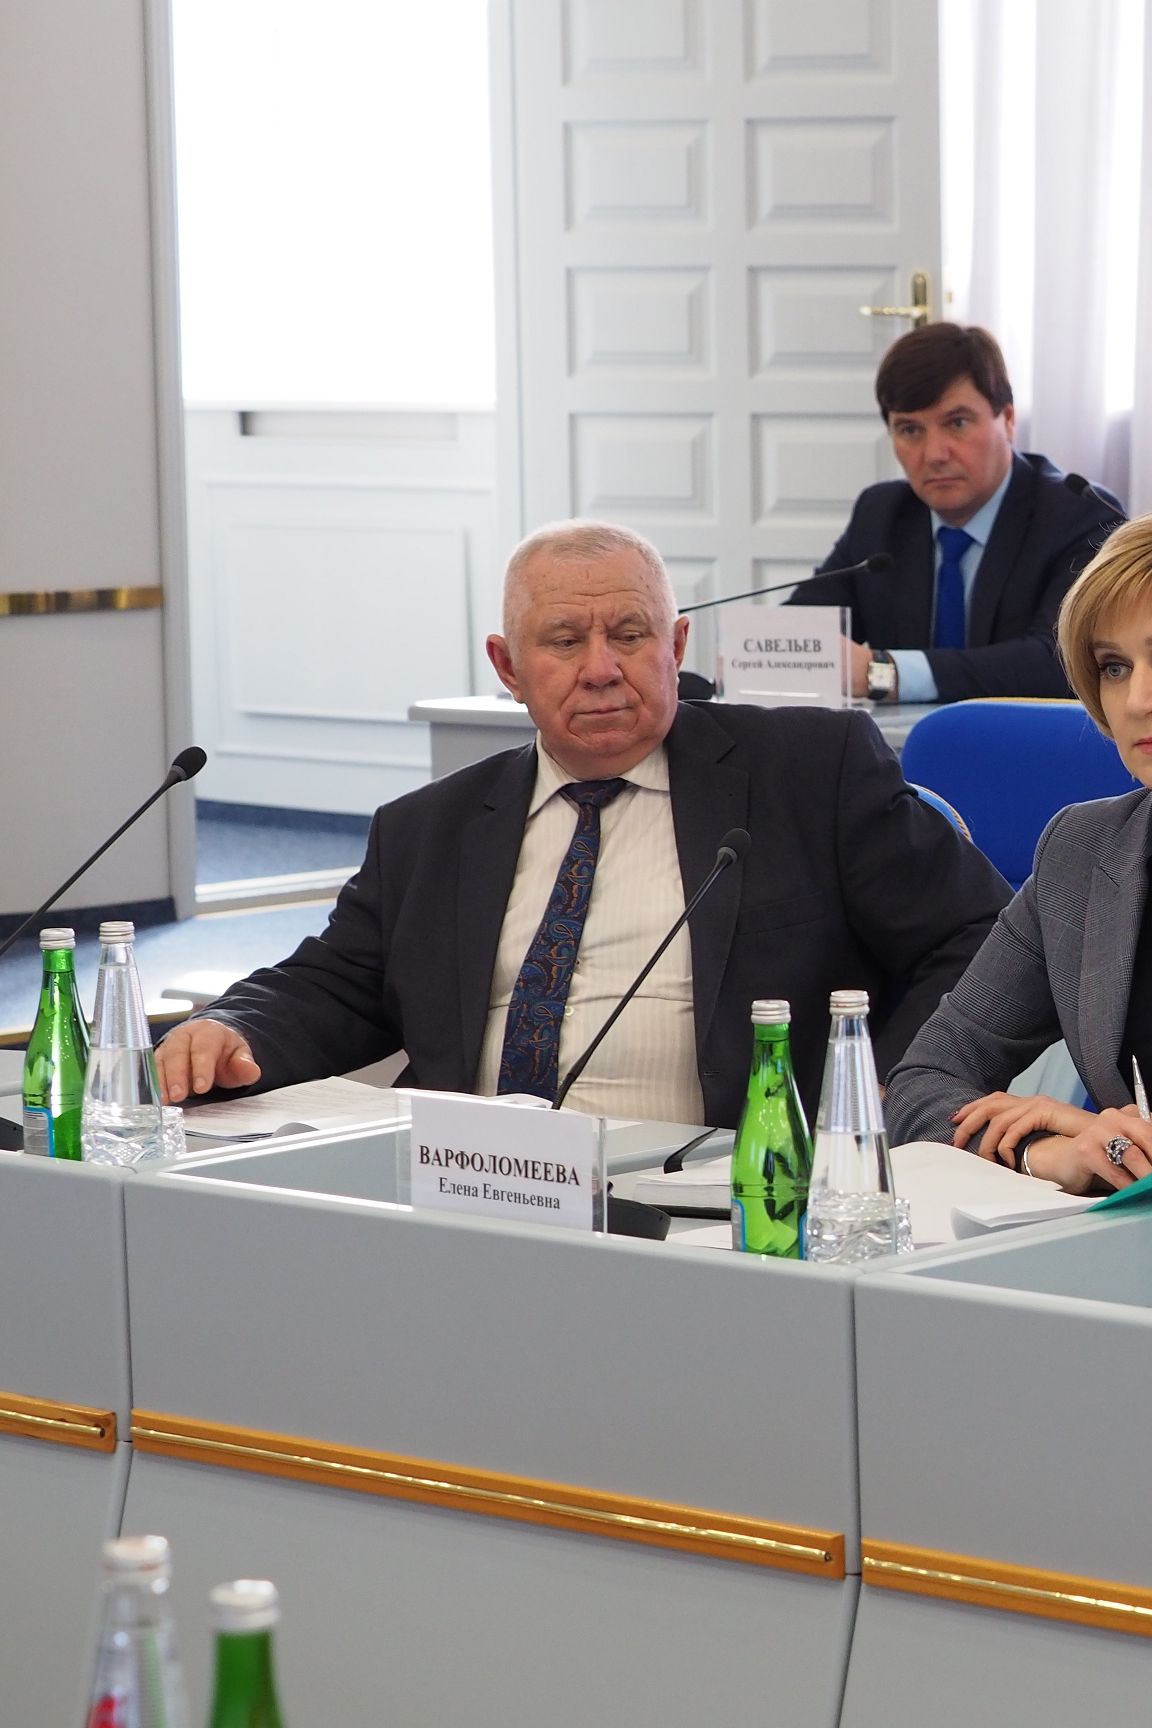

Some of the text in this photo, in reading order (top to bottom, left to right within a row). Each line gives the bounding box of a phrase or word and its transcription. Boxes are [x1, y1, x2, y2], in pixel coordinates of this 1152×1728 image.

[743, 638, 822, 653] САВЕЛЬЕВ
[731, 658, 835, 671] Сергей Александрович
[419, 1145, 581, 1186] ВАРФОЛОМЕЕВА
[438, 1176, 561, 1210] Елена Евгеньевна
